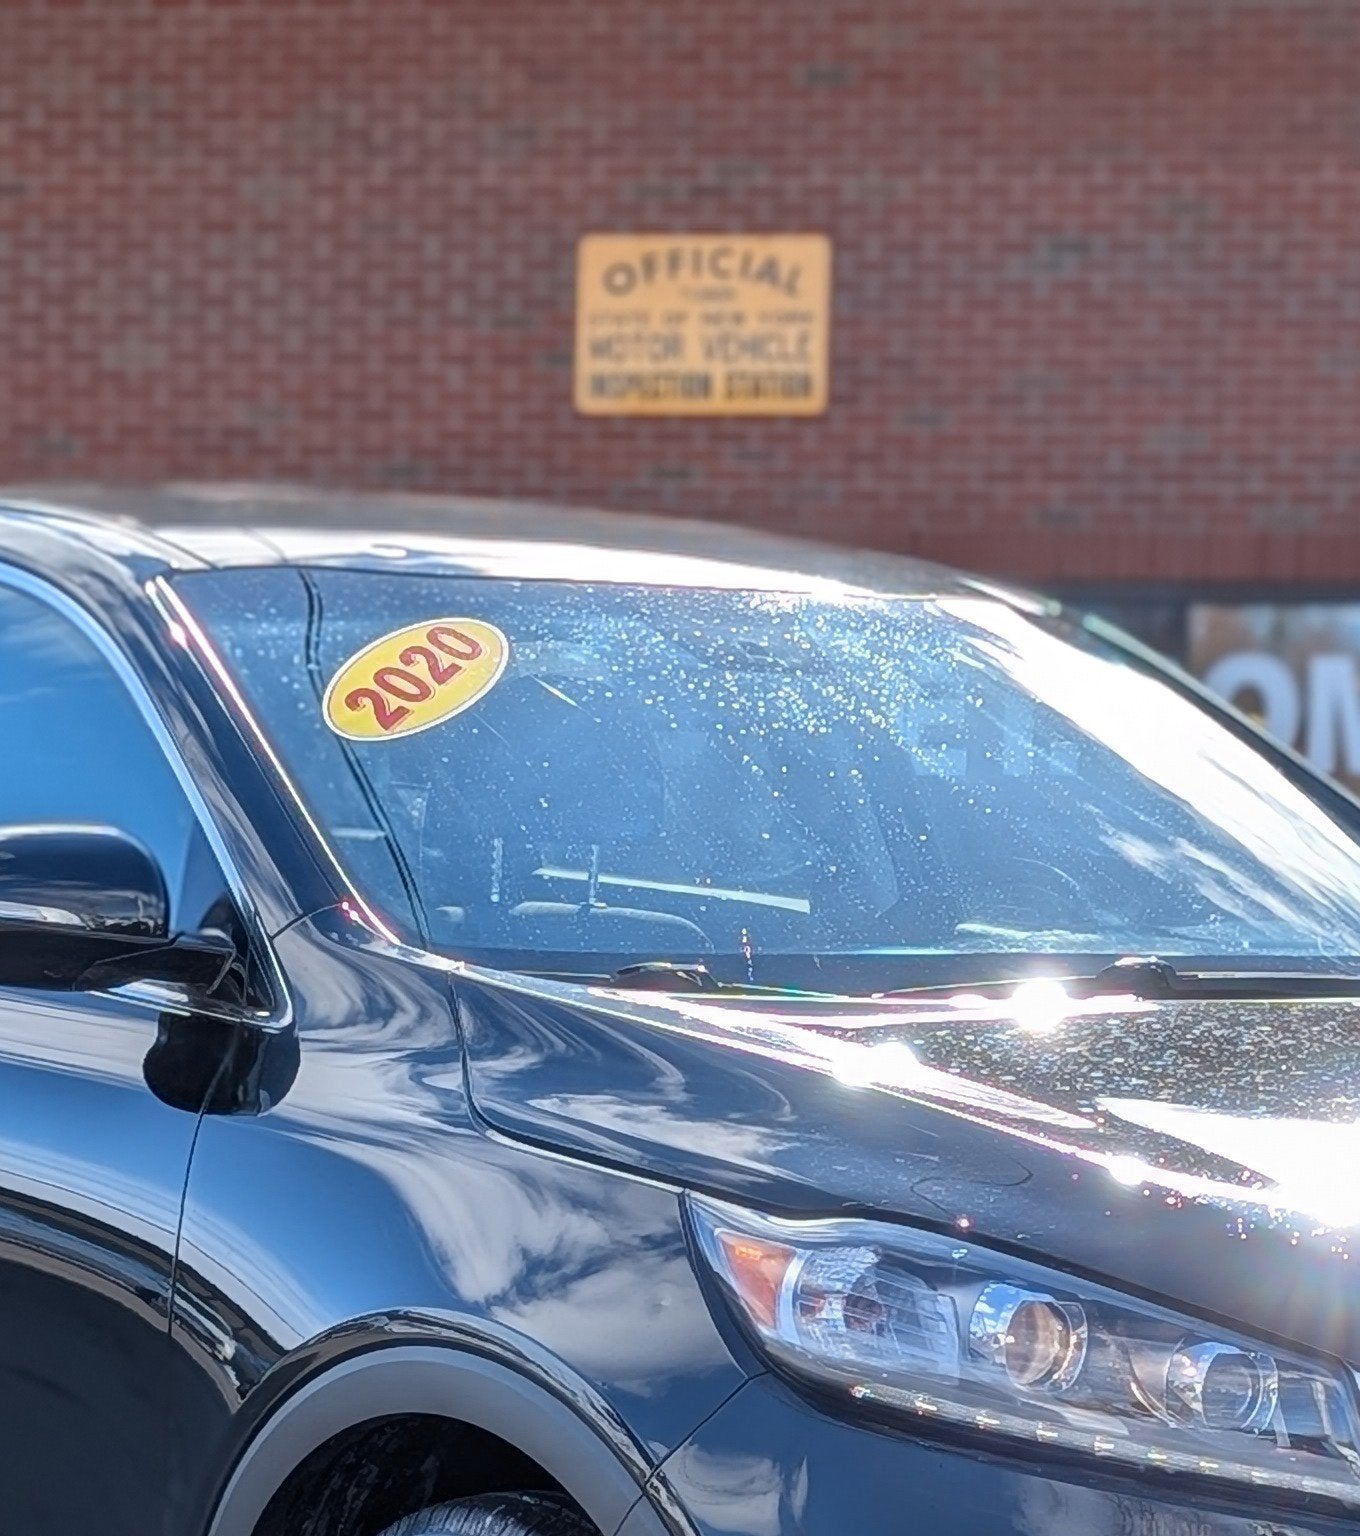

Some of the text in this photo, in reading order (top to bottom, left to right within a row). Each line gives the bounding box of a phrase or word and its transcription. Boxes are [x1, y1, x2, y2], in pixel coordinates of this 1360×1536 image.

[602, 246, 802, 298] OFFICIAL
[590, 330, 811, 362] MOTOR VEHICLE
[344, 626, 483, 731] 2020
